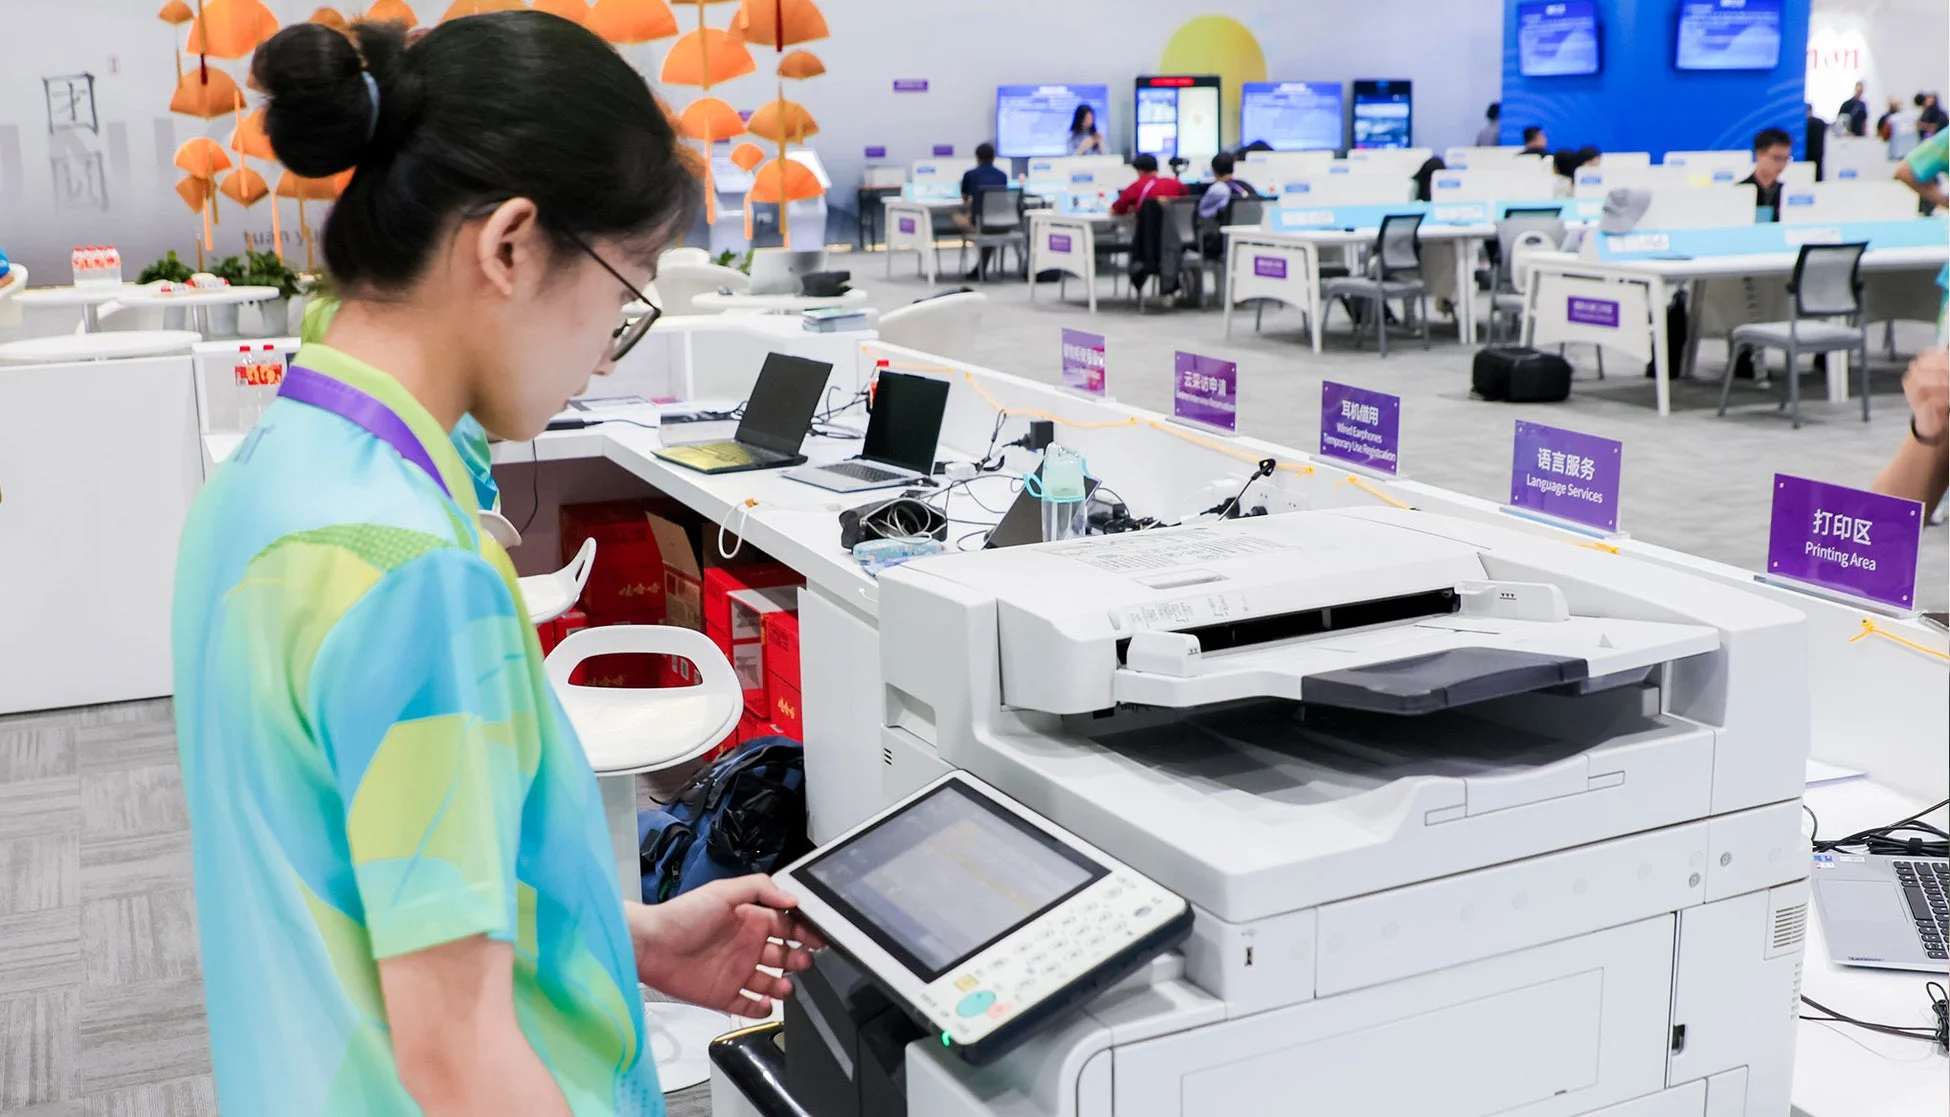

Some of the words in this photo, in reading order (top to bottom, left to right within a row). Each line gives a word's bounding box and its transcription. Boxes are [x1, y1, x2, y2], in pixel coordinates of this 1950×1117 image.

[1341, 399, 1379, 427] 耳机借用
[1323, 432, 1352, 453] Temporary
[1353, 426, 1383, 444] Earphones
[1537, 447, 1596, 481] 语言服务
[1526, 472, 1567, 497] Language
[1567, 483, 1604, 504] Services
[1812, 508, 1873, 546] 打印区
[1805, 541, 1850, 568] Printing
[1849, 552, 1877, 571] Area
